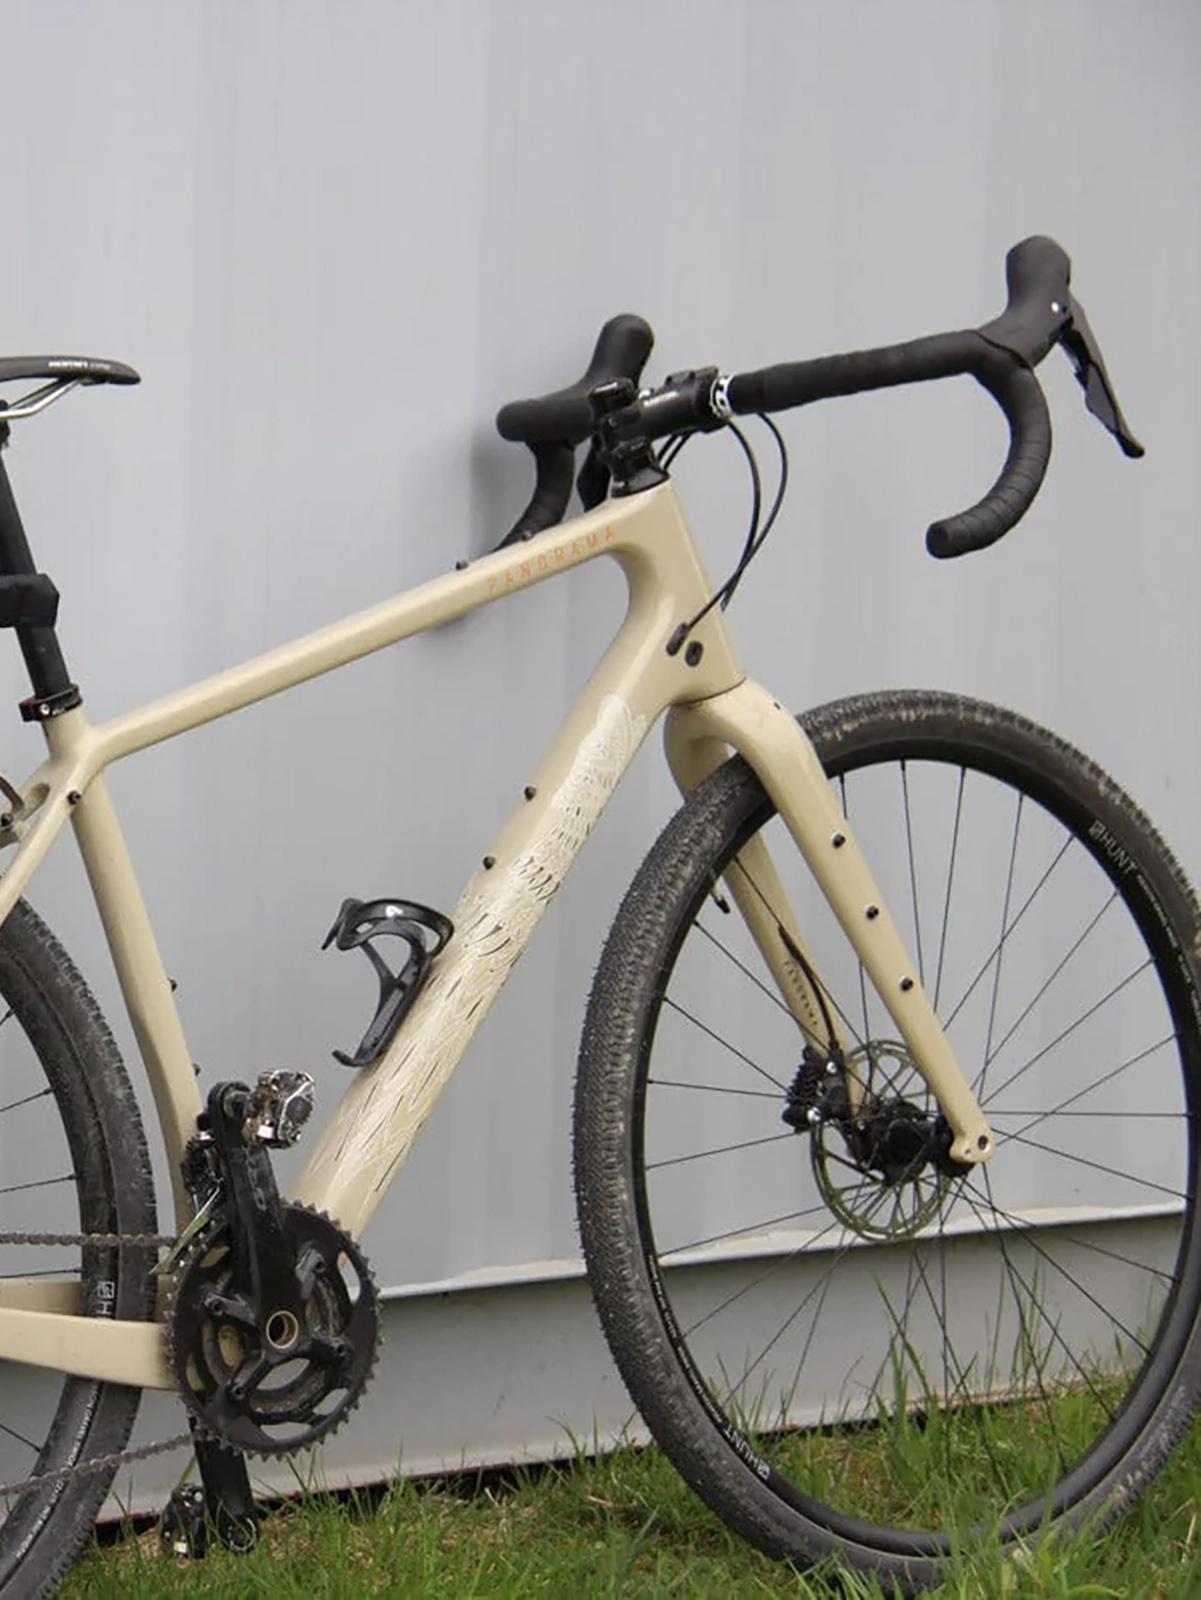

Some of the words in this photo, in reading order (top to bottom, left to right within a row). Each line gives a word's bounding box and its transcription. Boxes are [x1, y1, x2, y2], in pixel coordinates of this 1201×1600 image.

[487, 525, 616, 595] PANORAMA
[1099, 831, 1139, 876] HUNT
[723, 1424, 760, 1468] HUNT
